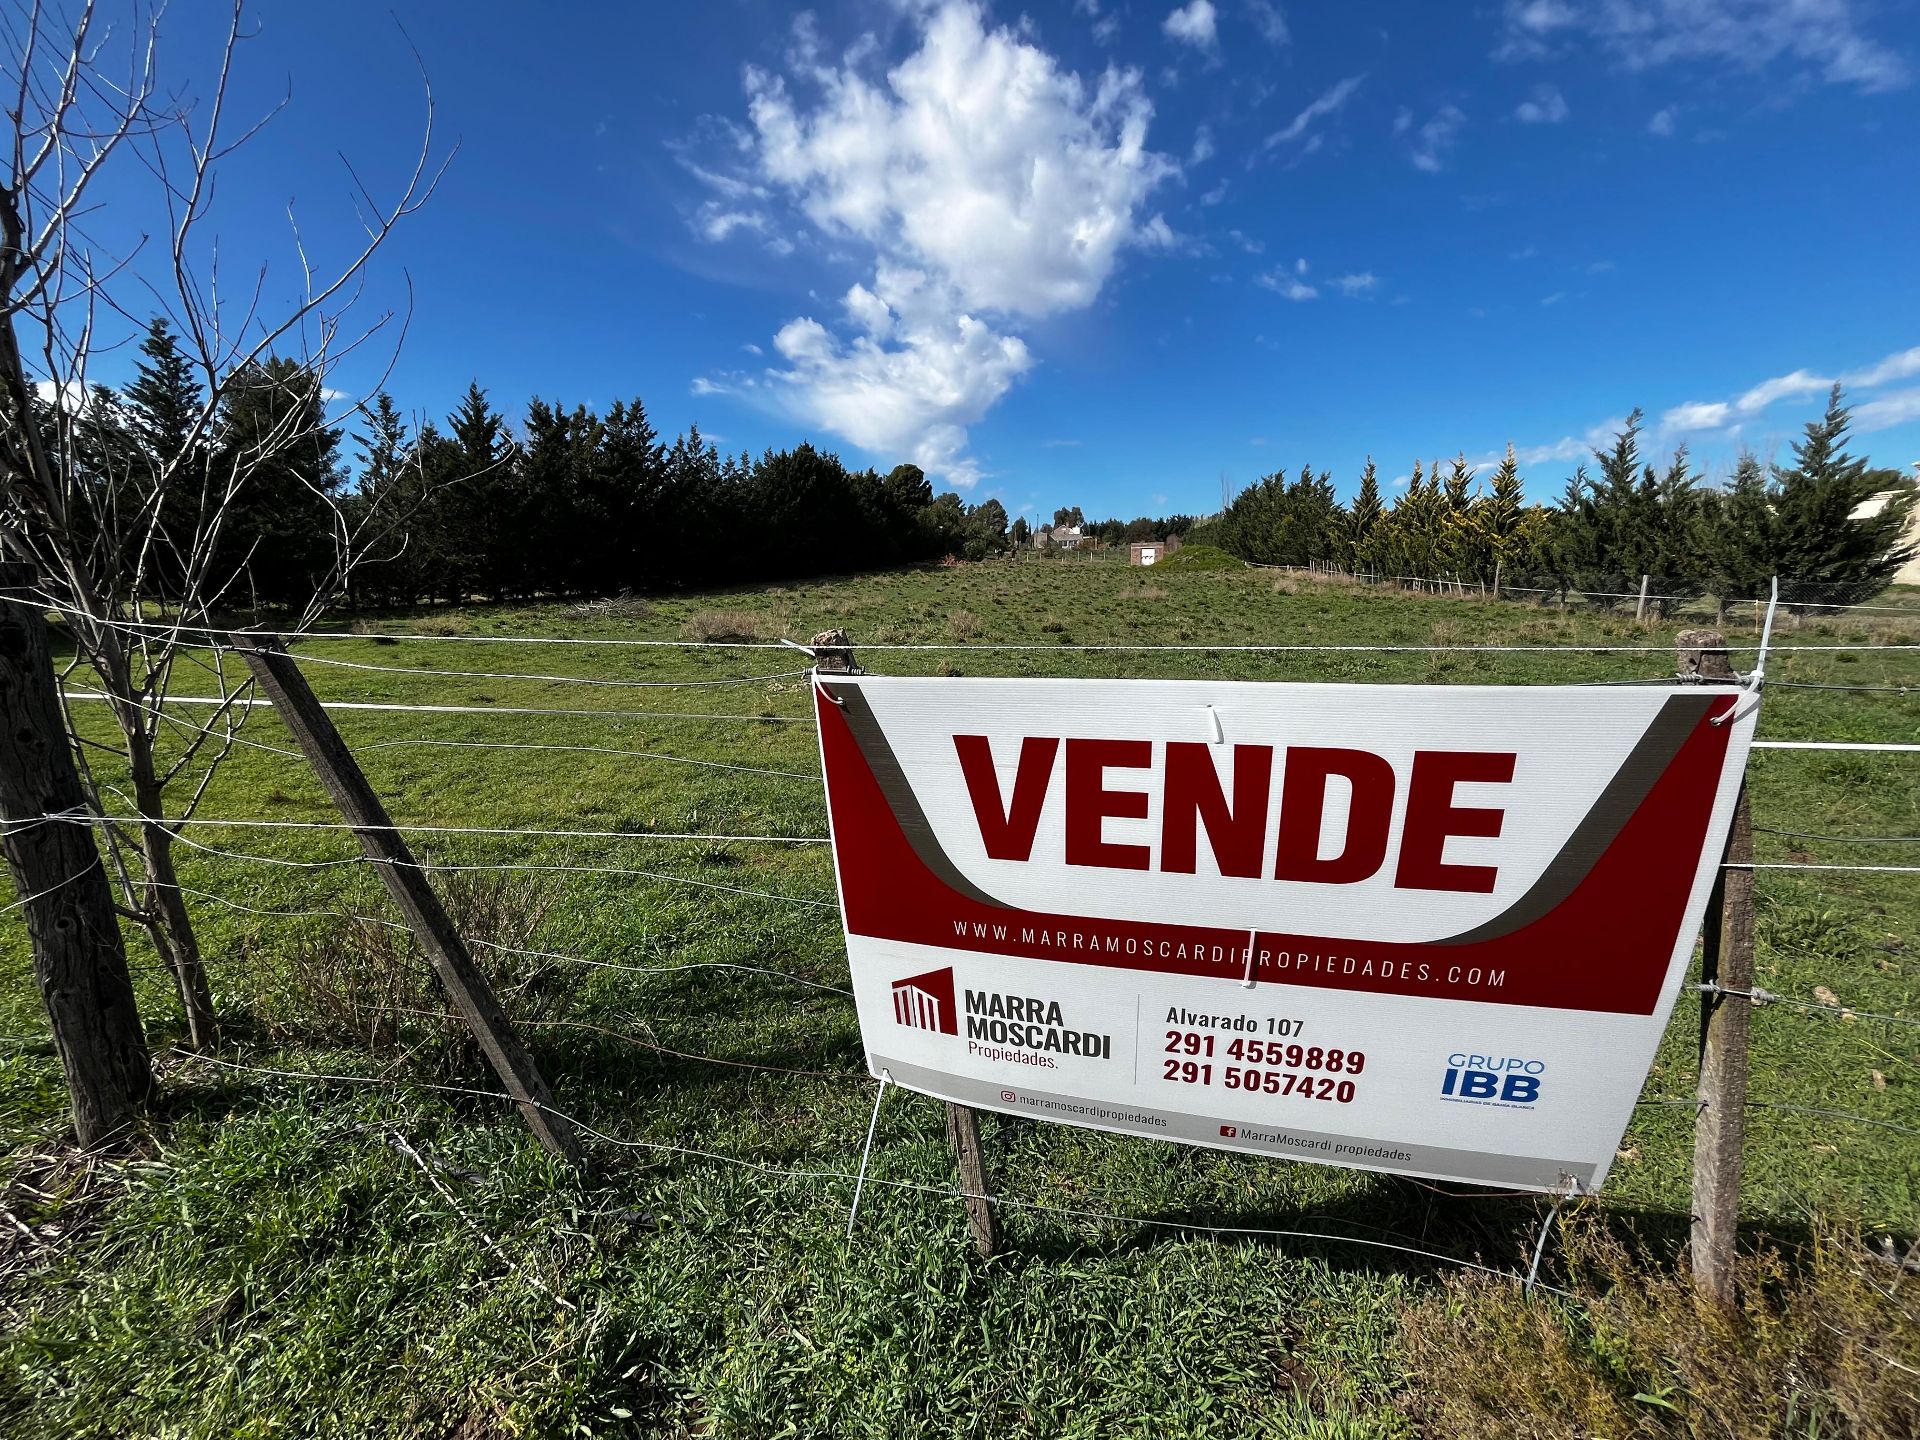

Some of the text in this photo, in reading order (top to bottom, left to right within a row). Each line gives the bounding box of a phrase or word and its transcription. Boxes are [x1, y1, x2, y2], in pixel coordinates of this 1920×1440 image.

[953, 735, 1516, 893] VENDE
[953, 920, 1506, 987] WWW.MARRAMOSCARDIPROPIEDADES.COM
[965, 989, 1064, 1027] MARRA
[1166, 1006, 1304, 1037] Alvarado 107
[967, 1017, 1111, 1059] MOSCARDI
[969, 1041, 1059, 1070] Propiedades.
[1165, 1031, 1366, 1075] 291 4559889
[1163, 1059, 1356, 1104] 291 5057420
[1447, 1053, 1545, 1075] GRUPO
[1441, 1069, 1541, 1102] IBB
[1019, 1095, 1168, 1128] marramoscardipropiedades
[1241, 1128, 1412, 1161] MarraMoscardi propiedades
